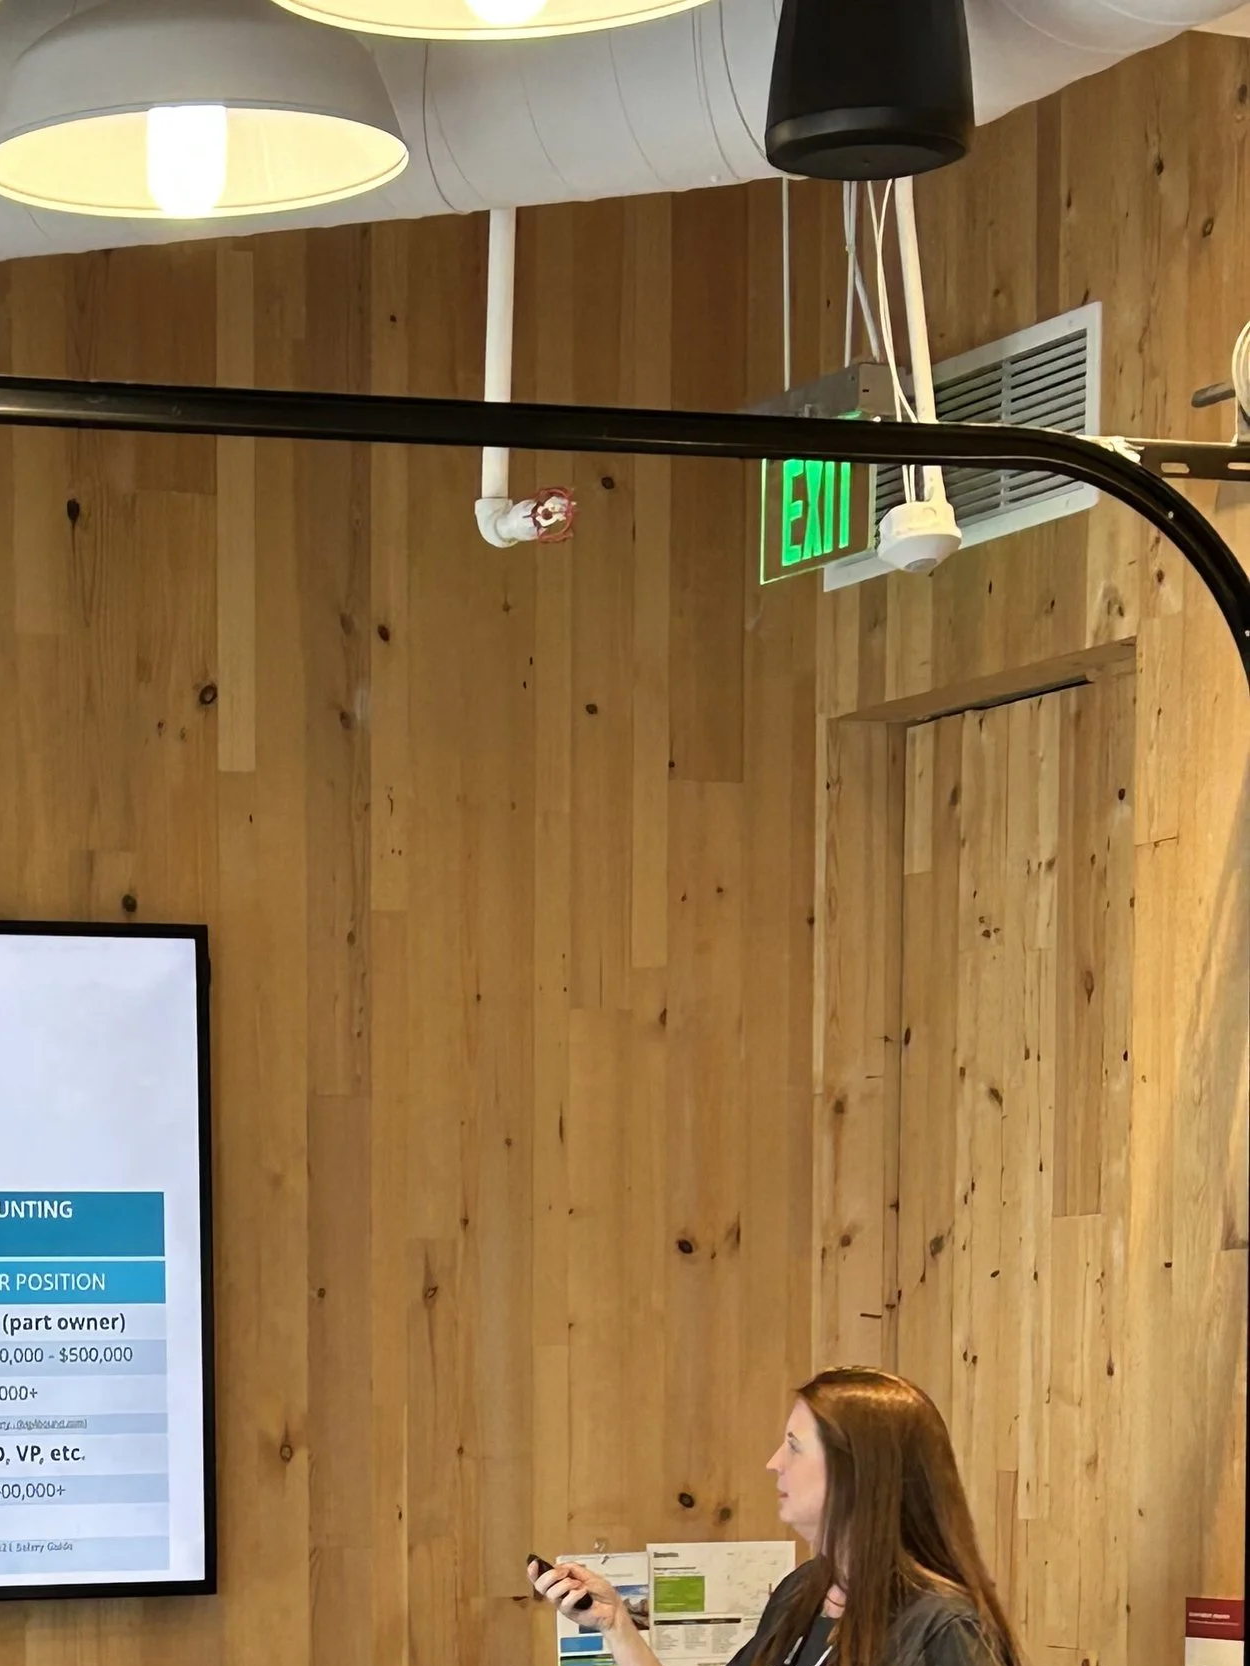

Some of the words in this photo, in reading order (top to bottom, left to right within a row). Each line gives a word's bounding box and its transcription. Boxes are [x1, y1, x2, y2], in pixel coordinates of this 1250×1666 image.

[16, 1273, 106, 1292] POSITION
[2, 1313, 52, 1336] (part
[58, 1313, 126, 1333] owner)
[59, 1346, 132, 1364] $500,000
[16, 1445, 44, 1464] VP,
[50, 1445, 85, 1462] etc.
